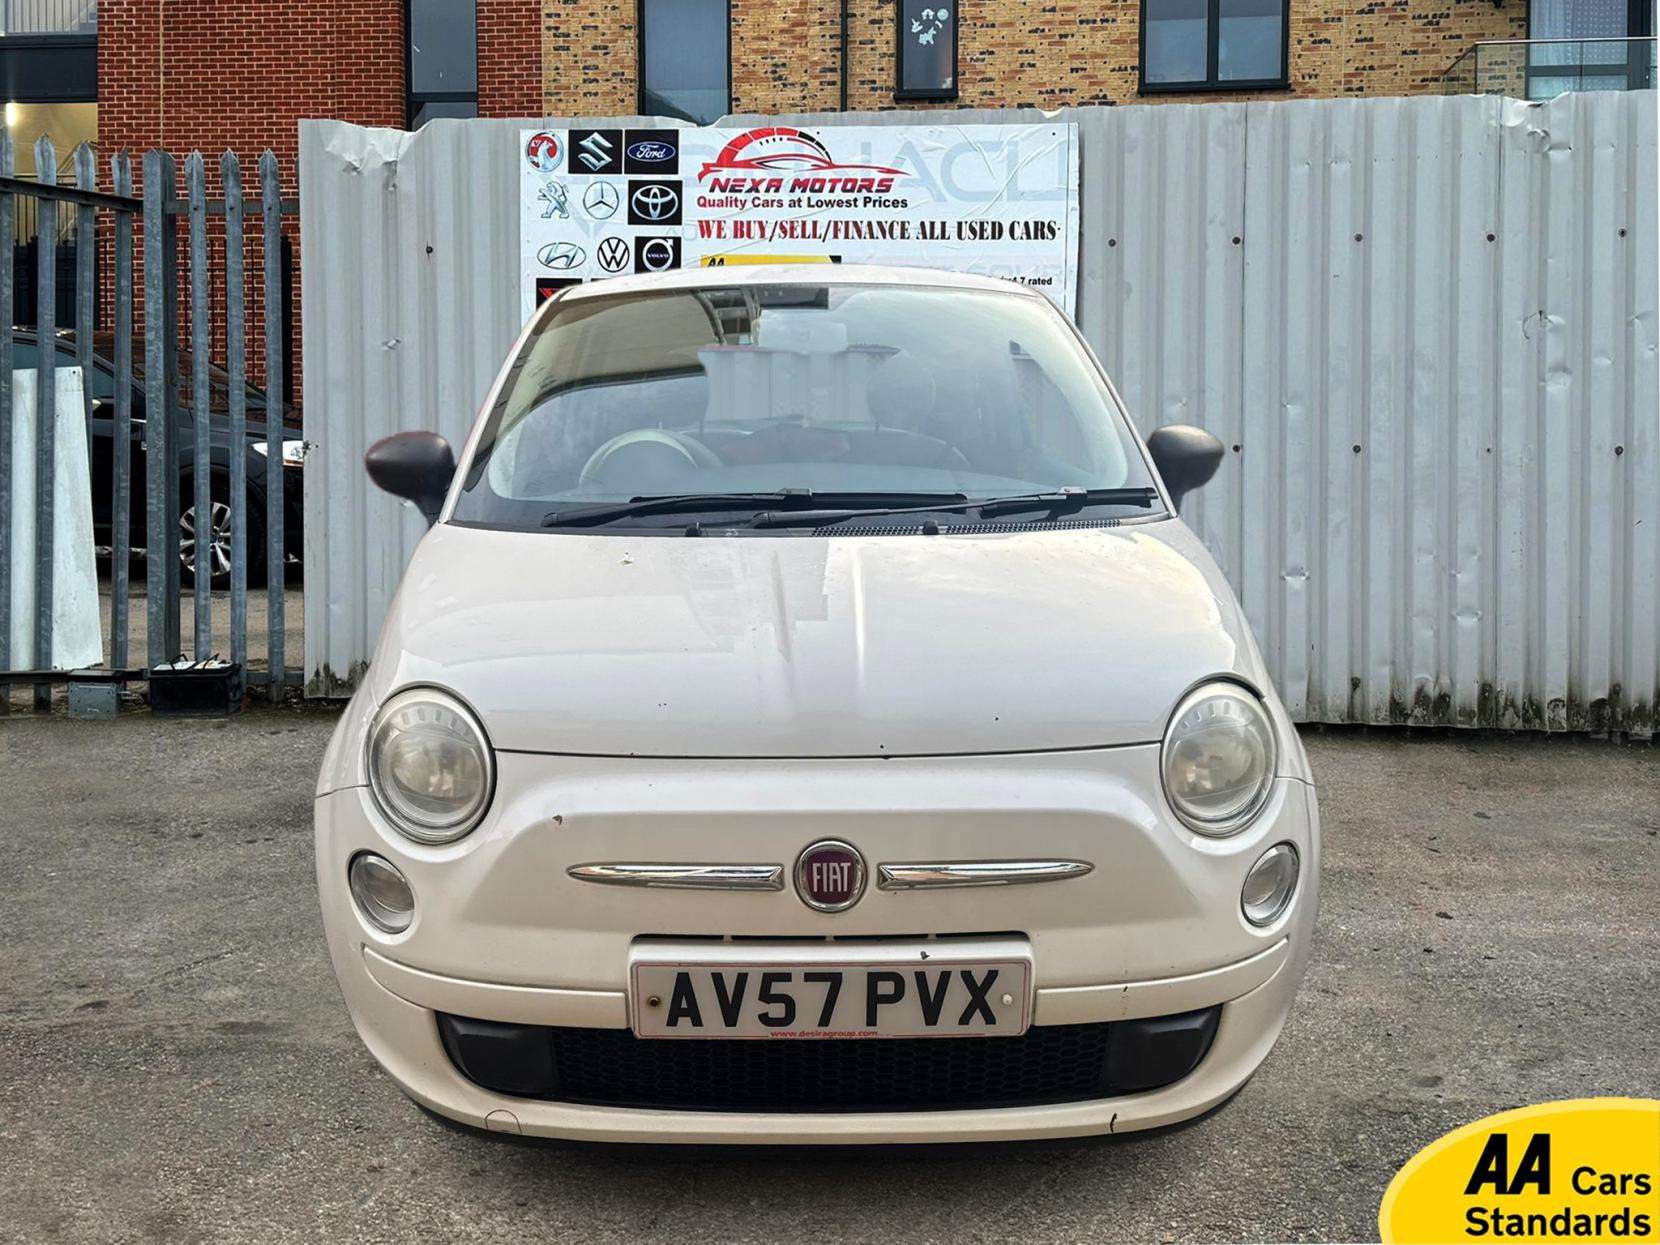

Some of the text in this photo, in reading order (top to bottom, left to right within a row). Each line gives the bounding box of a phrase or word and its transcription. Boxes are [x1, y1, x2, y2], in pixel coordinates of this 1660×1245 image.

[636, 144, 666, 159] Ford
[709, 177, 895, 194] NEXA MOTORS
[697, 195, 909, 211] Quality Cars at Lowest Prices
[697, 220, 727, 240] WE
[915, 220, 951, 241] ALL
[956, 220, 1004, 241] USED
[1008, 220, 1057, 241] CARS
[1028, 276, 1053, 286] rated
[812, 862, 852, 892] FIAT
[666, 969, 999, 1028] AV57 PVX
[770, 1030, 878, 1039] www.desiragroup.com
